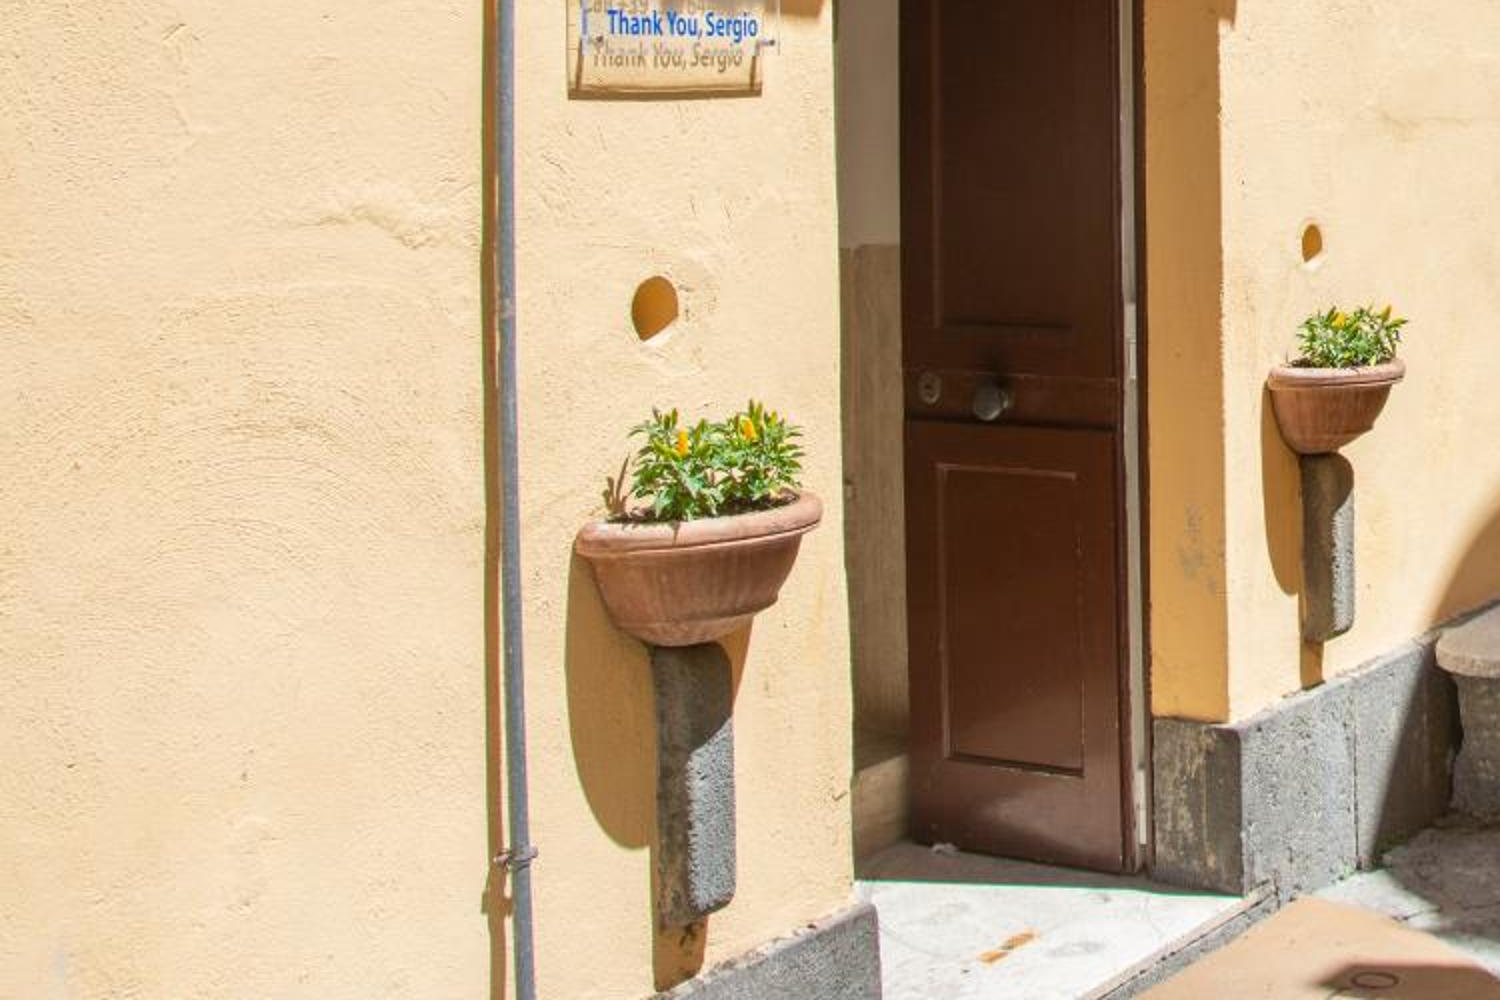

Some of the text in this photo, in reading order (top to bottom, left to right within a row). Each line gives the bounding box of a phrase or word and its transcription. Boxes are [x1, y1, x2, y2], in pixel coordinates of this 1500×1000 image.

[607, 9, 758, 43] Thank You, Sergio
